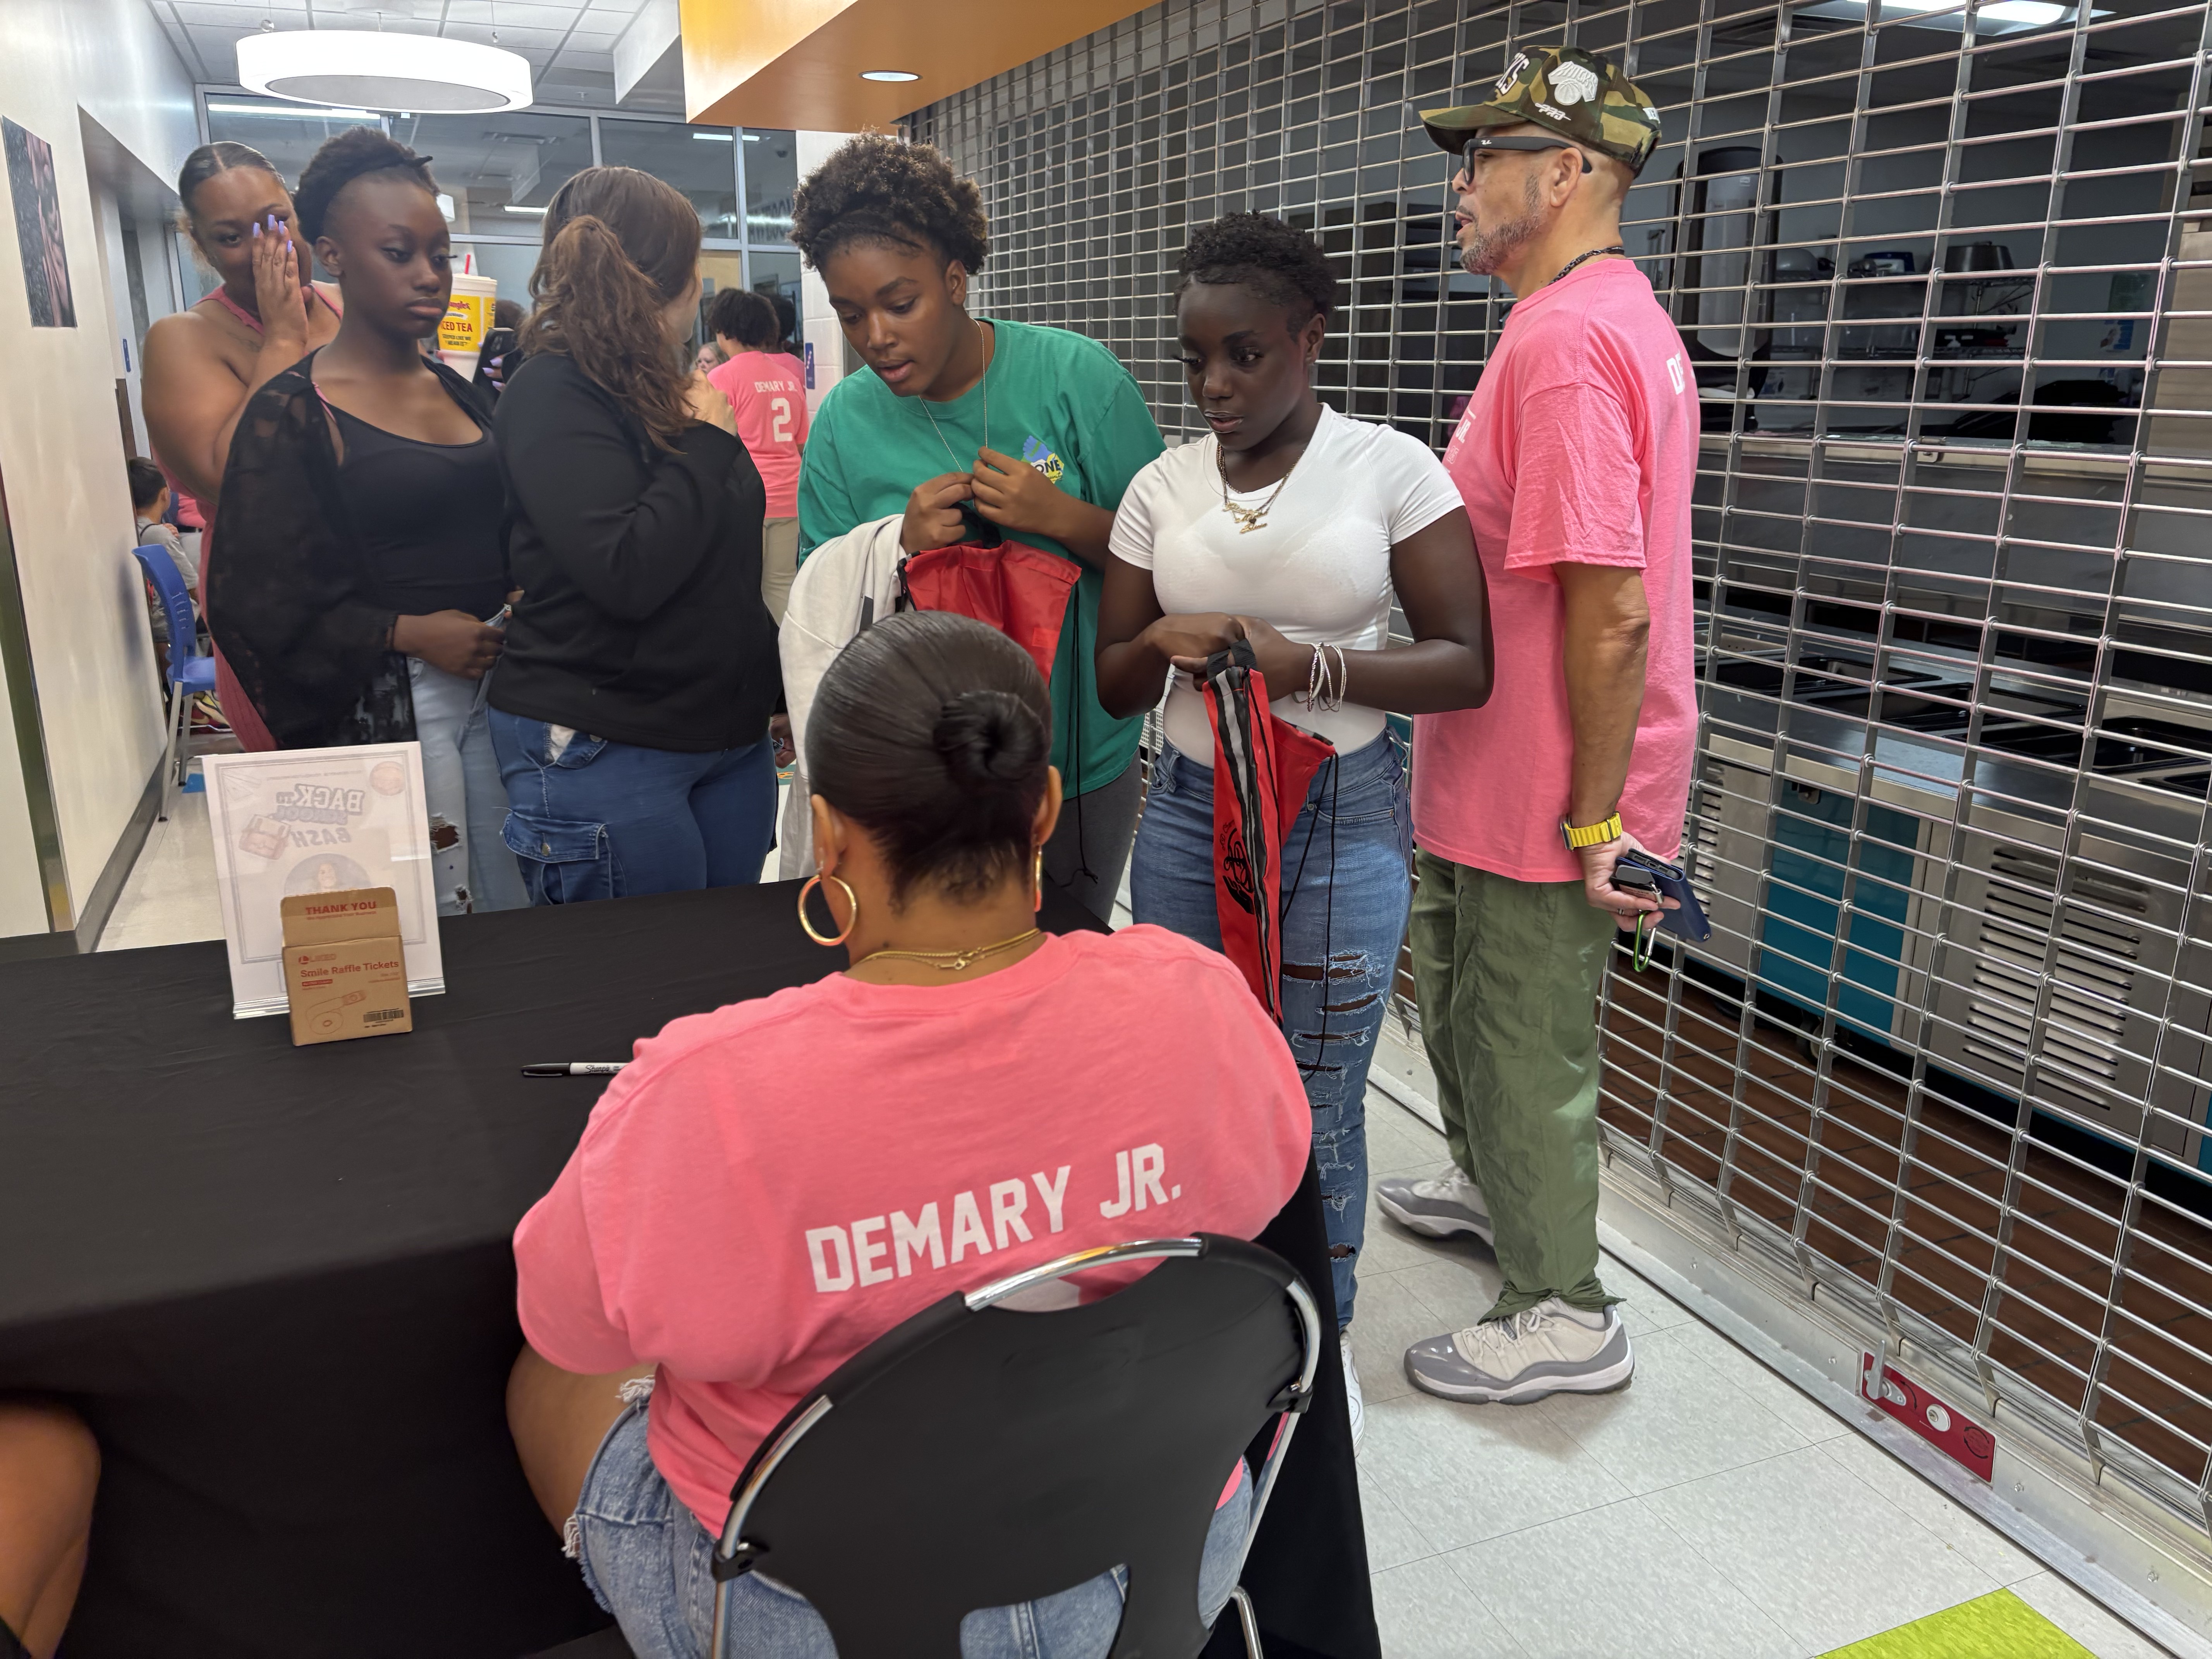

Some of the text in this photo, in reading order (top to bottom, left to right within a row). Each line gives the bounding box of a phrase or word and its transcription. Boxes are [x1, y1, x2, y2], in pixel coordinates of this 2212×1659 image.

[456, 322, 473, 332] TEA
[754, 380, 785, 393] DEMARY
[771, 397, 793, 442] 2
[305, 901, 376, 915] THANK YOU
[301, 960, 399, 977] Smile Raffle Tickets
[805, 1143, 1181, 1293] DEMARY JR.
